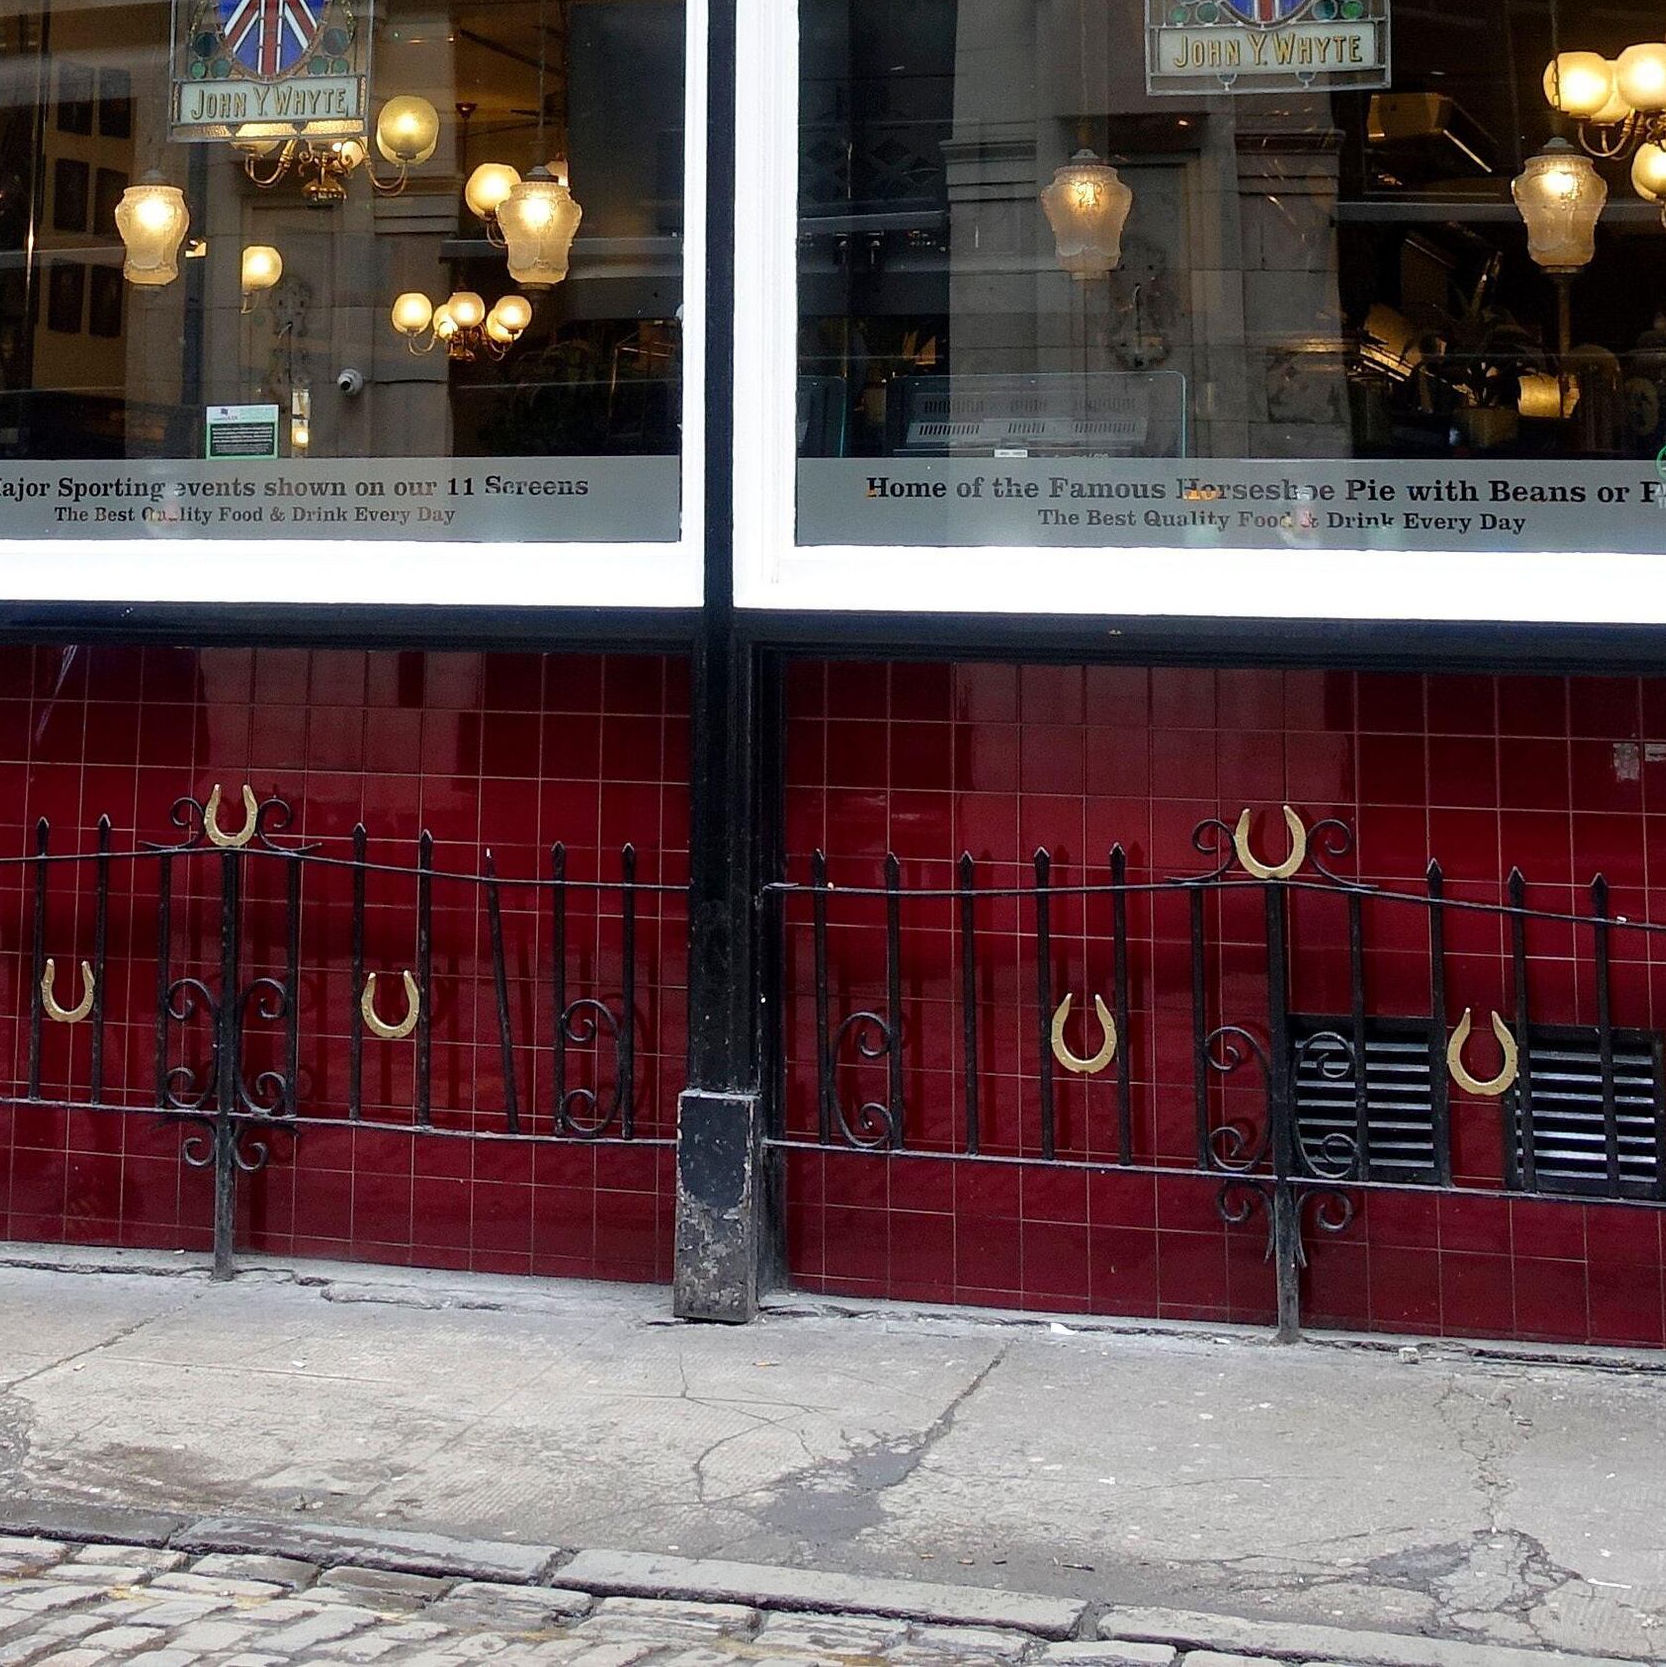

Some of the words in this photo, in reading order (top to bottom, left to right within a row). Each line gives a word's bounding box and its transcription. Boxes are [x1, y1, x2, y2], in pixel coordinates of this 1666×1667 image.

[58, 477, 166, 502] Sporting
[173, 479, 256, 496] events
[264, 477, 347, 496] shown
[355, 482, 386, 496] on
[393, 482, 437, 496] our
[446, 477, 475, 496] 11
[484, 475, 590, 496] Screens
[866, 477, 947, 499] Home
[956, 475, 985, 499] of
[991, 477, 1040, 499] the
[1048, 477, 1167, 500] Famous
[1345, 479, 1396, 501] Pie
[1406, 479, 1480, 501] with
[1488, 480, 1587, 503] Beans
[1597, 484, 1631, 503] or
[54, 506, 89, 522] The
[94, 506, 136, 522] Best
[218, 506, 264, 522] Food
[269, 507, 286, 522] &
[292, 506, 348, 522] Drink
[355, 506, 411, 525] Every
[418, 506, 456, 525] Day
[1038, 509, 1080, 526] The
[1086, 509, 1137, 526] Best
[1144, 509, 1231, 531] Quality
[1238, 511, 1292, 528] Food
[1326, 512, 1395, 530] Drink
[1403, 512, 1473, 533] Every
[1480, 512, 1526, 533] Day
